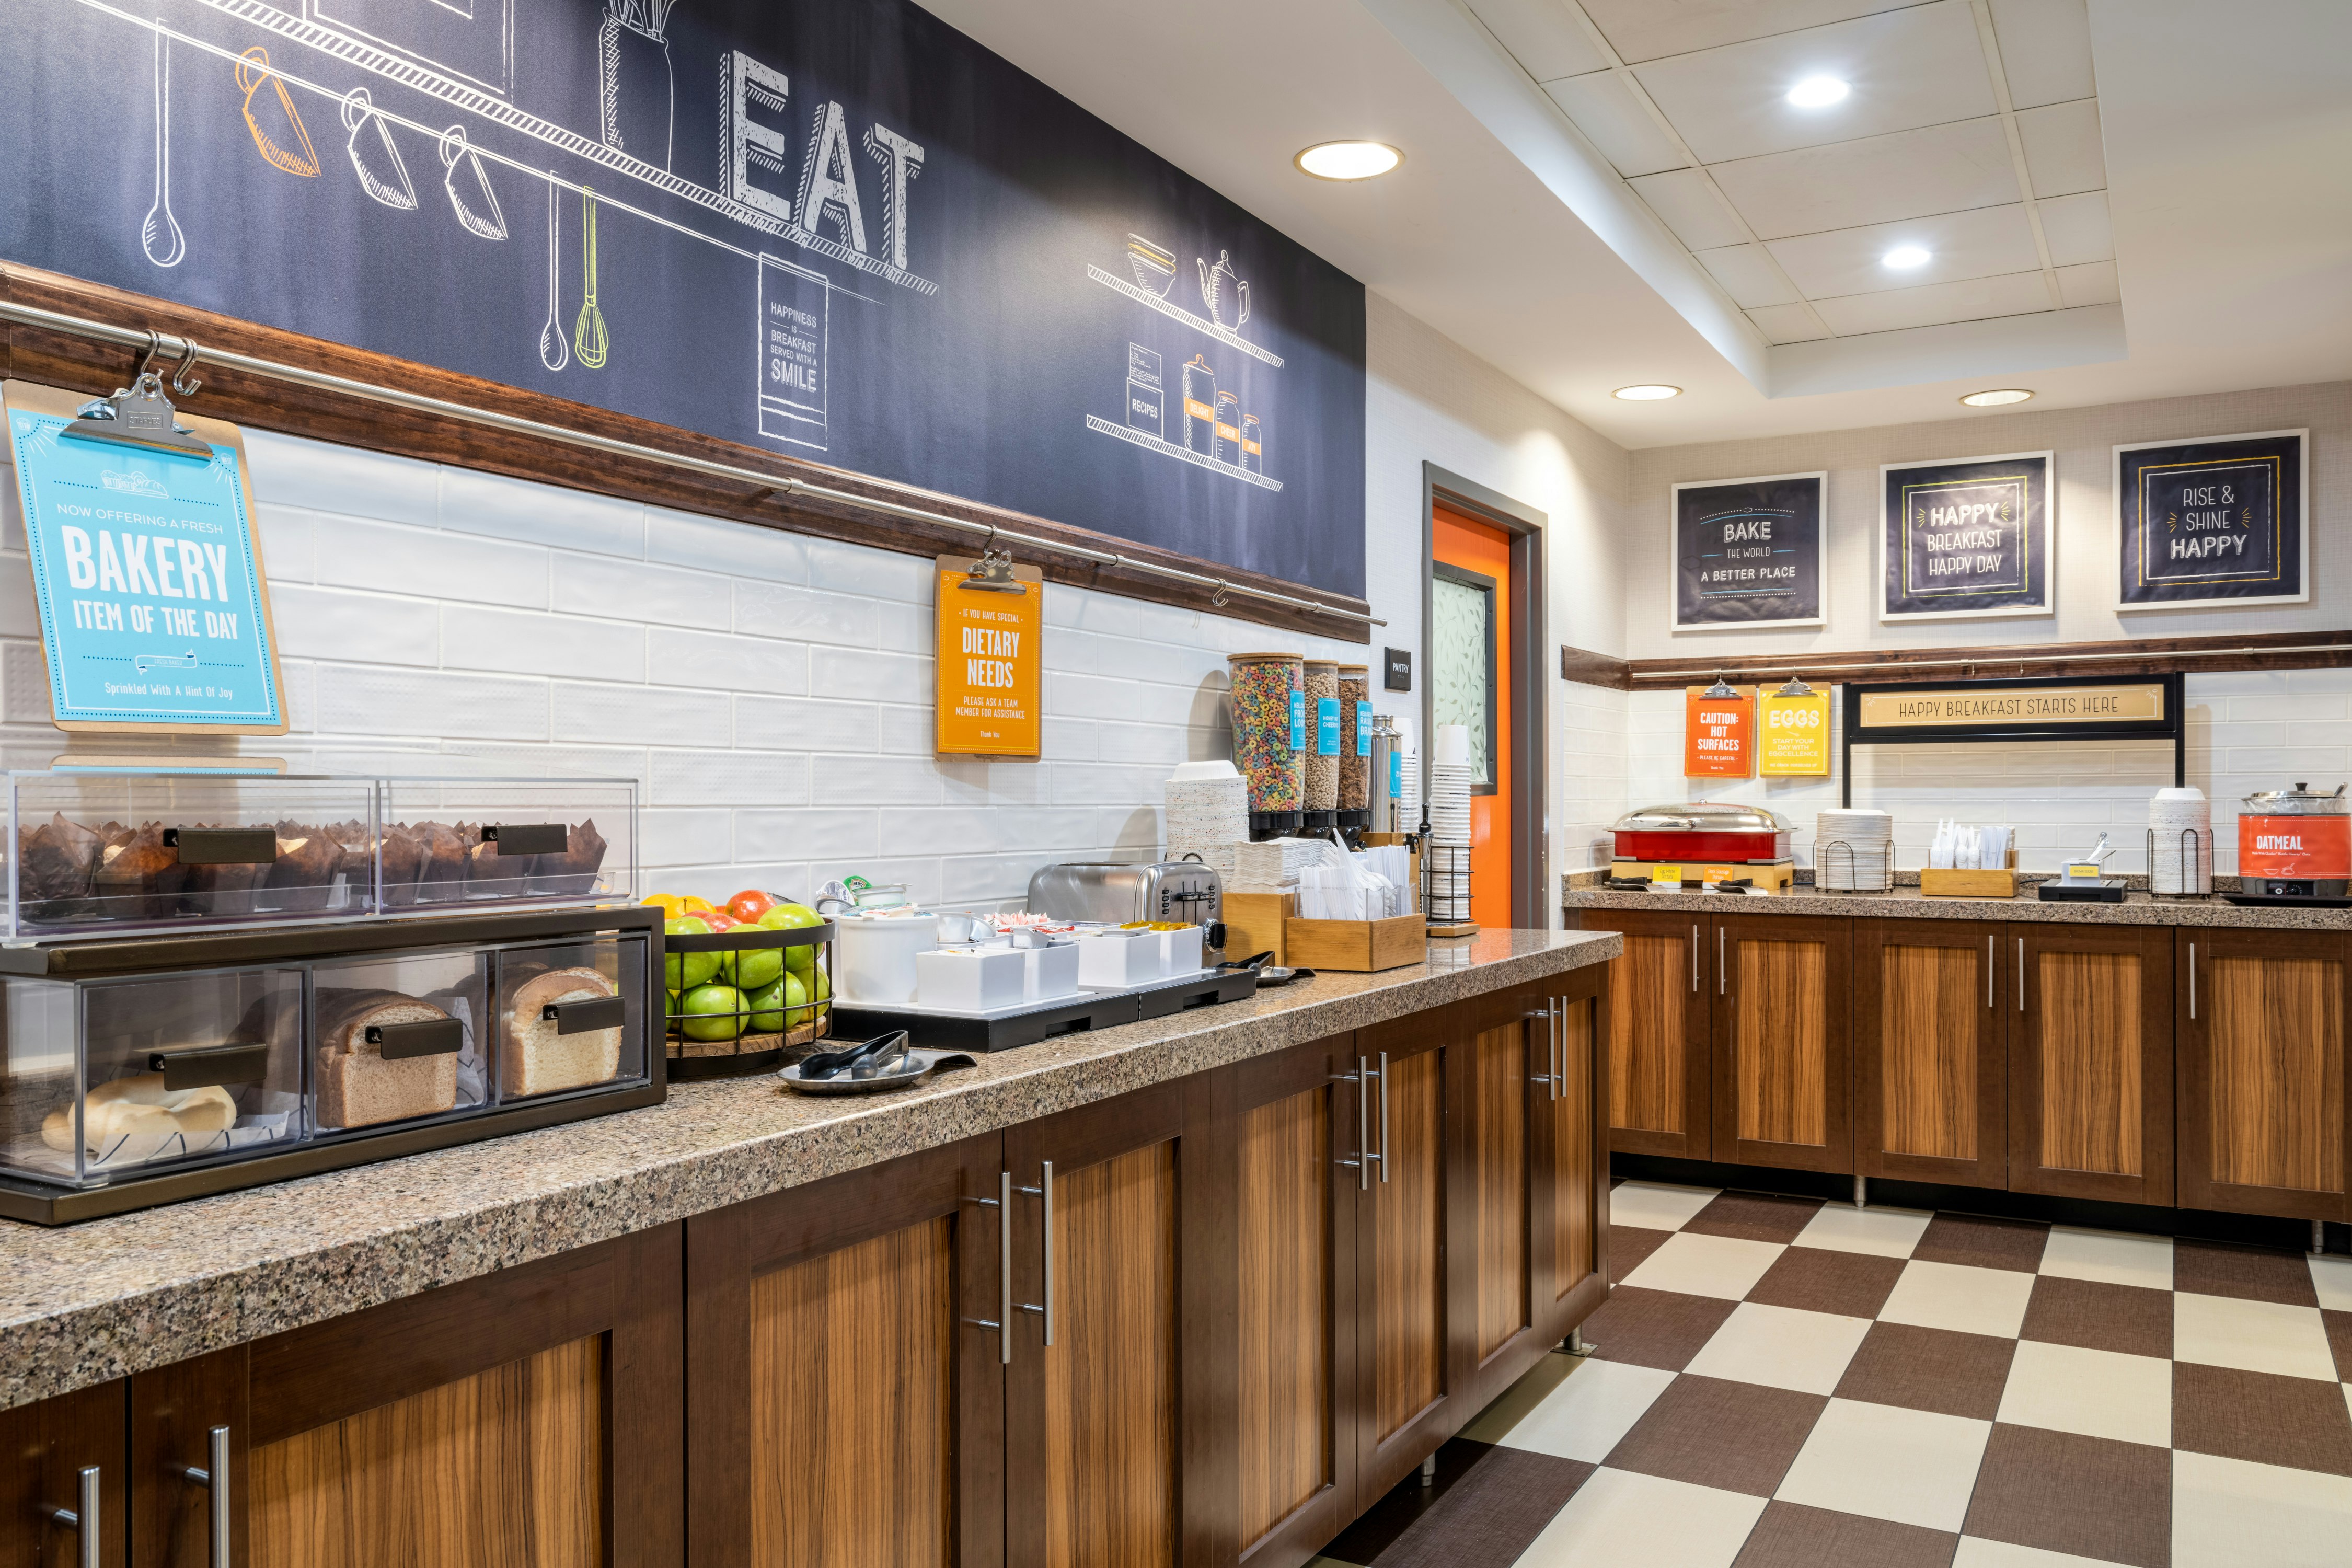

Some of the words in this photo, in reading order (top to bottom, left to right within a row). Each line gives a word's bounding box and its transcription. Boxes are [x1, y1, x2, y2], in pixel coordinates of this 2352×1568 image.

[721, 50, 925, 273] EAT
[771, 302, 816, 328] HAPPINESS
[791, 325, 797, 333] IS
[771, 329, 816, 354] BREAKFAST
[770, 344, 794, 359] SERVED
[796, 352, 811, 365] WITH
[813, 359, 817, 367] A
[771, 358, 816, 392] SMILE
[1132, 398, 1158, 419] RECIPES
[1190, 402, 1209, 418] DELIGHT
[1220, 425, 1235, 439] CHEER
[1248, 443, 1256, 452] JOY
[2183, 487, 2216, 506] RISE
[2221, 485, 2234, 504] &
[57, 504, 91, 517] NOW
[96, 509, 166, 527] OFFERING
[170, 519, 179, 528] A
[181, 520, 223, 534] FRESH
[1930, 502, 1999, 527] HAPPY
[2186, 510, 2231, 531] SHINE
[1724, 522, 1771, 543] BAKE
[1928, 529, 2002, 551] BREAKFAST
[1727, 549, 1740, 559] THE
[1743, 547, 1770, 558] WORLD
[2170, 534, 2247, 559] HAPPY
[61, 525, 228, 602] BAKERY
[1700, 571, 1708, 582] A
[1713, 569, 1755, 581] BETTER
[1760, 566, 1795, 579] PLACE
[1929, 556, 1972, 575] HAPPY
[1977, 555, 2002, 573] DAY
[73, 599, 124, 631] ITEM
[130, 605, 154, 633] OF
[160, 607, 200, 637] THE
[204, 610, 238, 640] DAY
[963, 608, 968, 617] IF
[970, 609, 980, 619] YOU
[982, 611, 995, 620] HAVE
[997, 613, 1020, 623] SPECIAL
[963, 627, 1020, 658] DIETARY
[967, 659, 1013, 688] NEEDS
[1393, 662, 1409, 673] PANTRY
[105, 682, 147, 696] Sprinkled
[150, 684, 171, 696] With
[176, 686, 181, 696] A
[185, 686, 203, 697] Hint
[206, 686, 215, 697] Of
[218, 687, 233, 700] Joy
[963, 696, 984, 706] PLEASE
[986, 697, 996, 707] ASK
[998, 698, 1002, 707] A
[1004, 698, 1018, 708] TEAM
[1899, 701, 1941, 718] HAPPY
[1947, 699, 2021, 717] BREAKFAST
[2027, 698, 2077, 714] STARTS
[2083, 696, 2118, 713] HERE
[955, 707, 979, 716] MEMBER
[982, 708, 991, 717] FOR
[994, 709, 1025, 719] ASSISTANCE
[1700, 712, 1739, 724] CAUTION:
[1769, 709, 1819, 728] EGGS
[1711, 725, 1727, 737] HOT
[1697, 738, 1739, 751] SURFACES
[2257, 835, 2303, 850] OATMEAL
